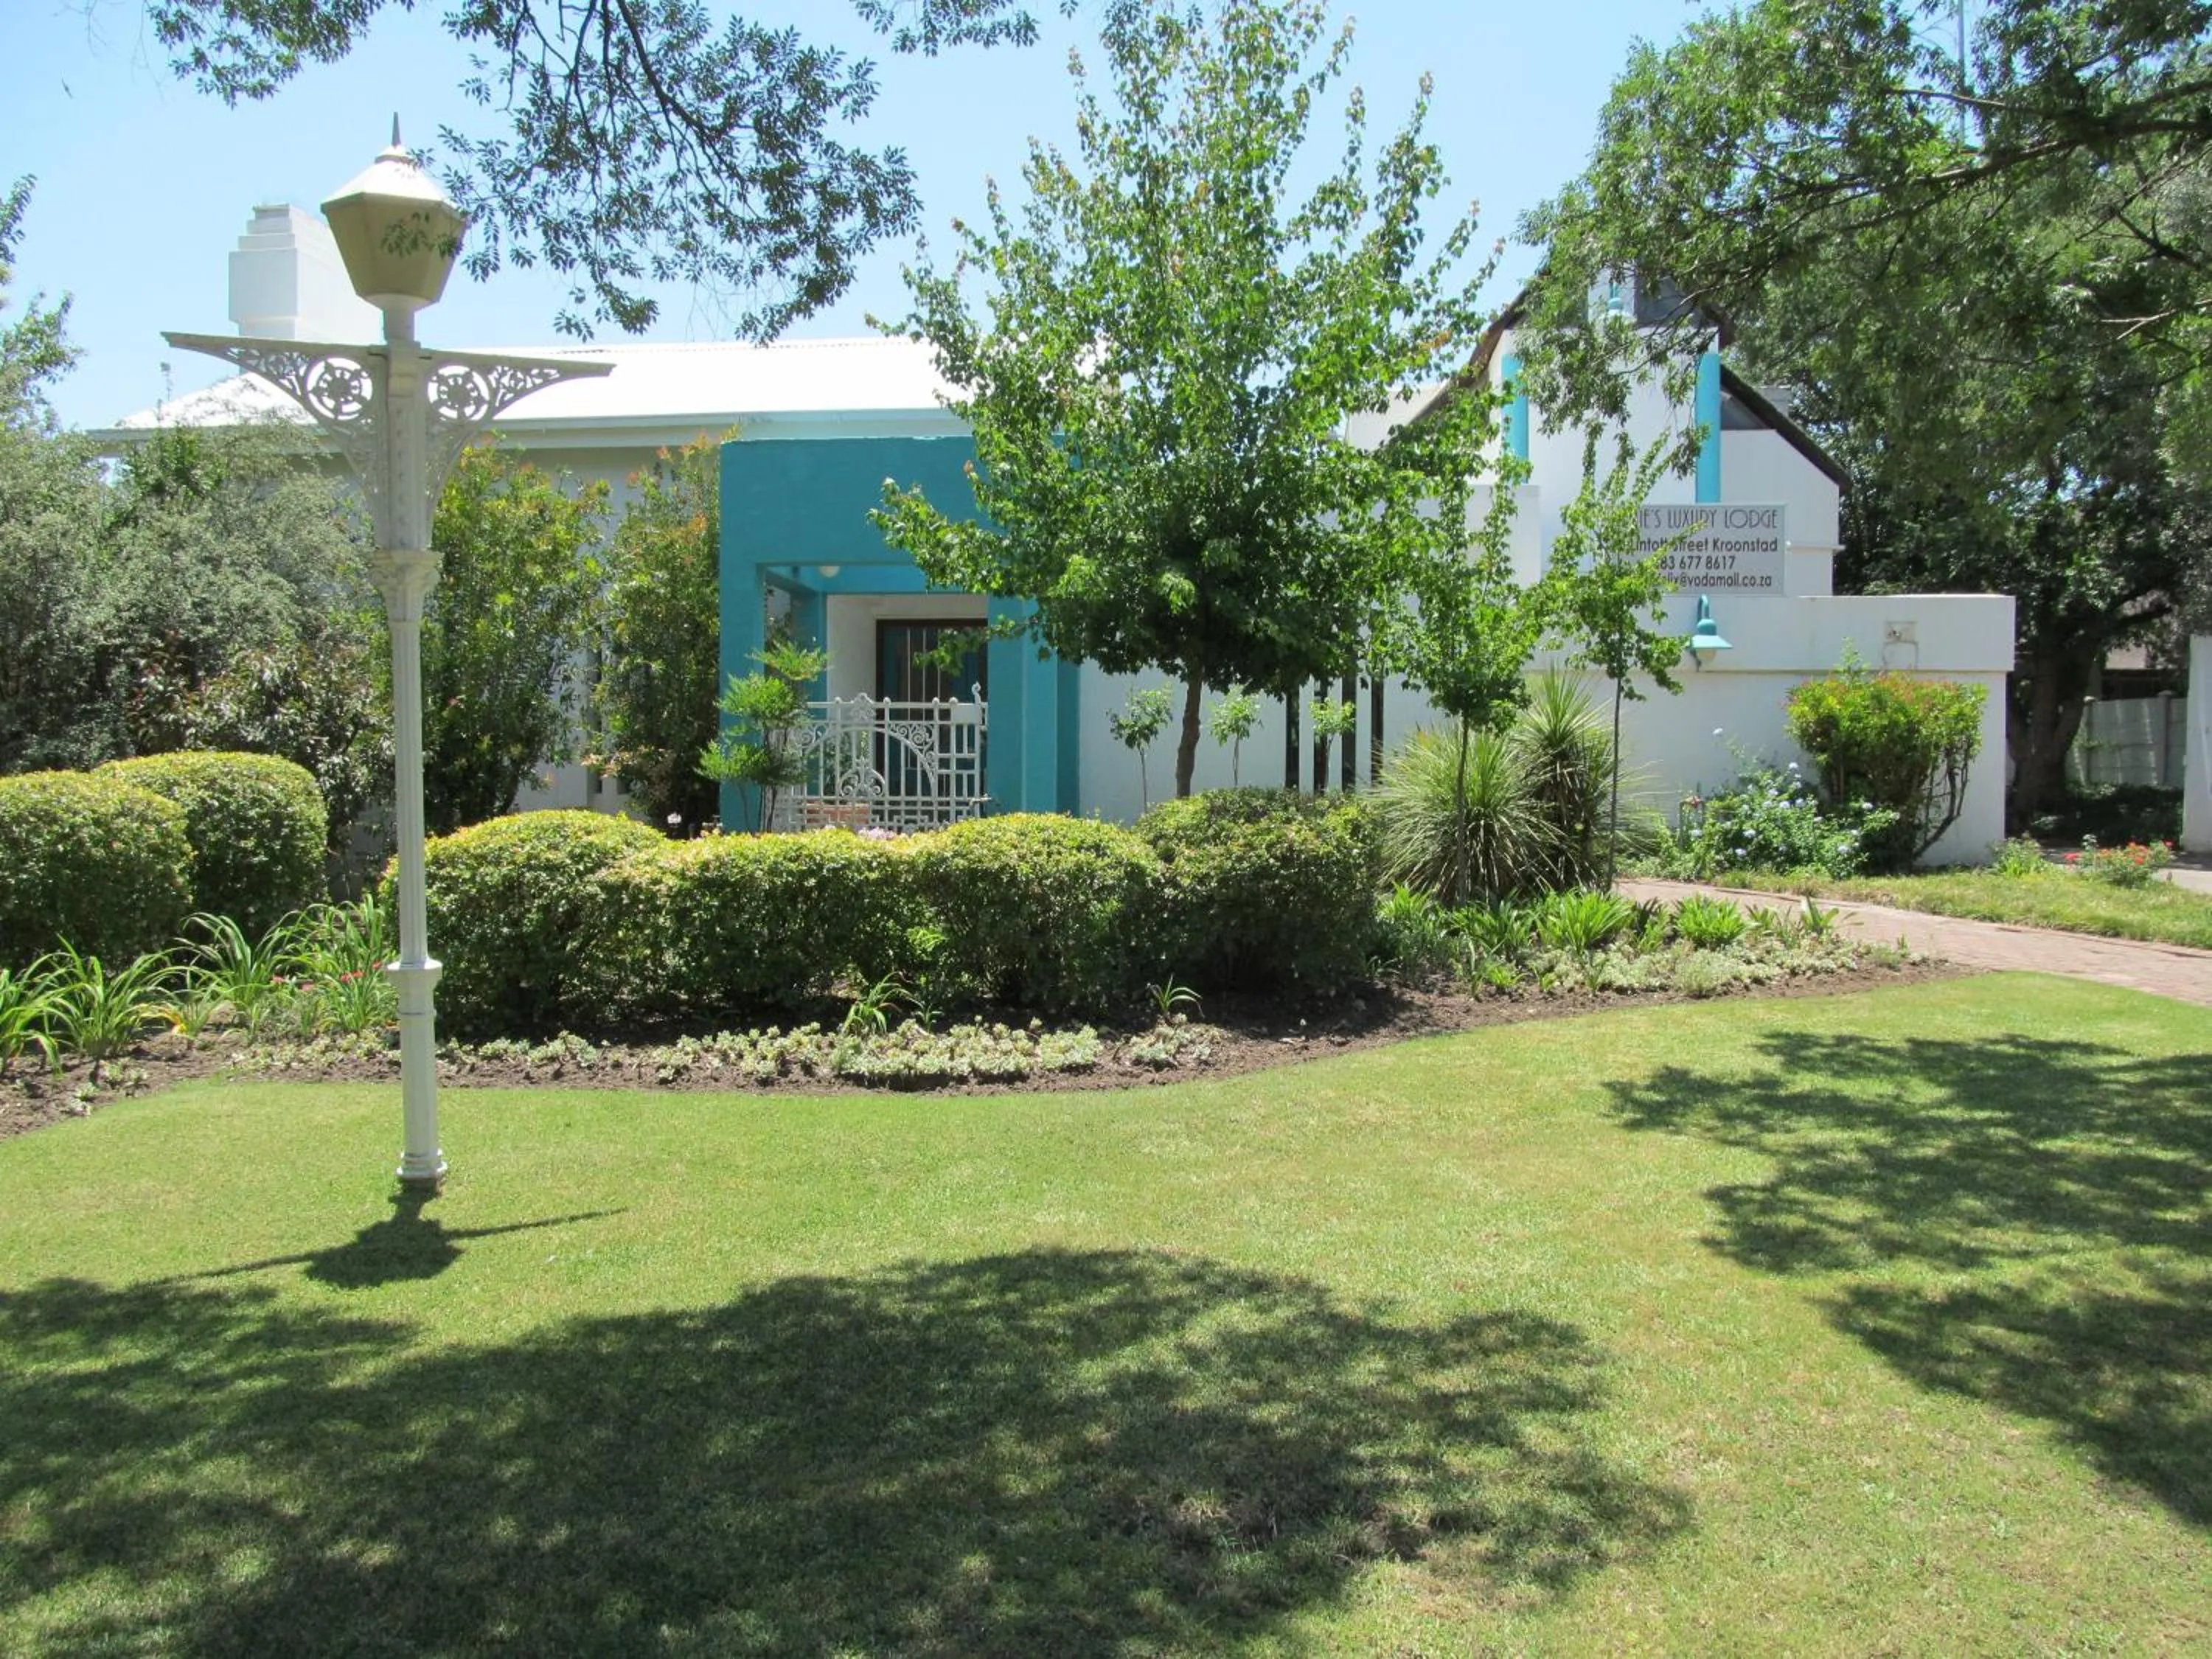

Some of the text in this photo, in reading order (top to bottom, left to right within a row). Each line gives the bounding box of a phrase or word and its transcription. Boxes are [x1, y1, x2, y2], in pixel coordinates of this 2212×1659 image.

[1638, 508, 1778, 529] IE'S LUXURY LODGE
[1713, 537, 1778, 552] Kroonstad
[1659, 555, 1736, 570] 83 677 8617
[1659, 571, 1772, 587] lix@vodamail.co.za
